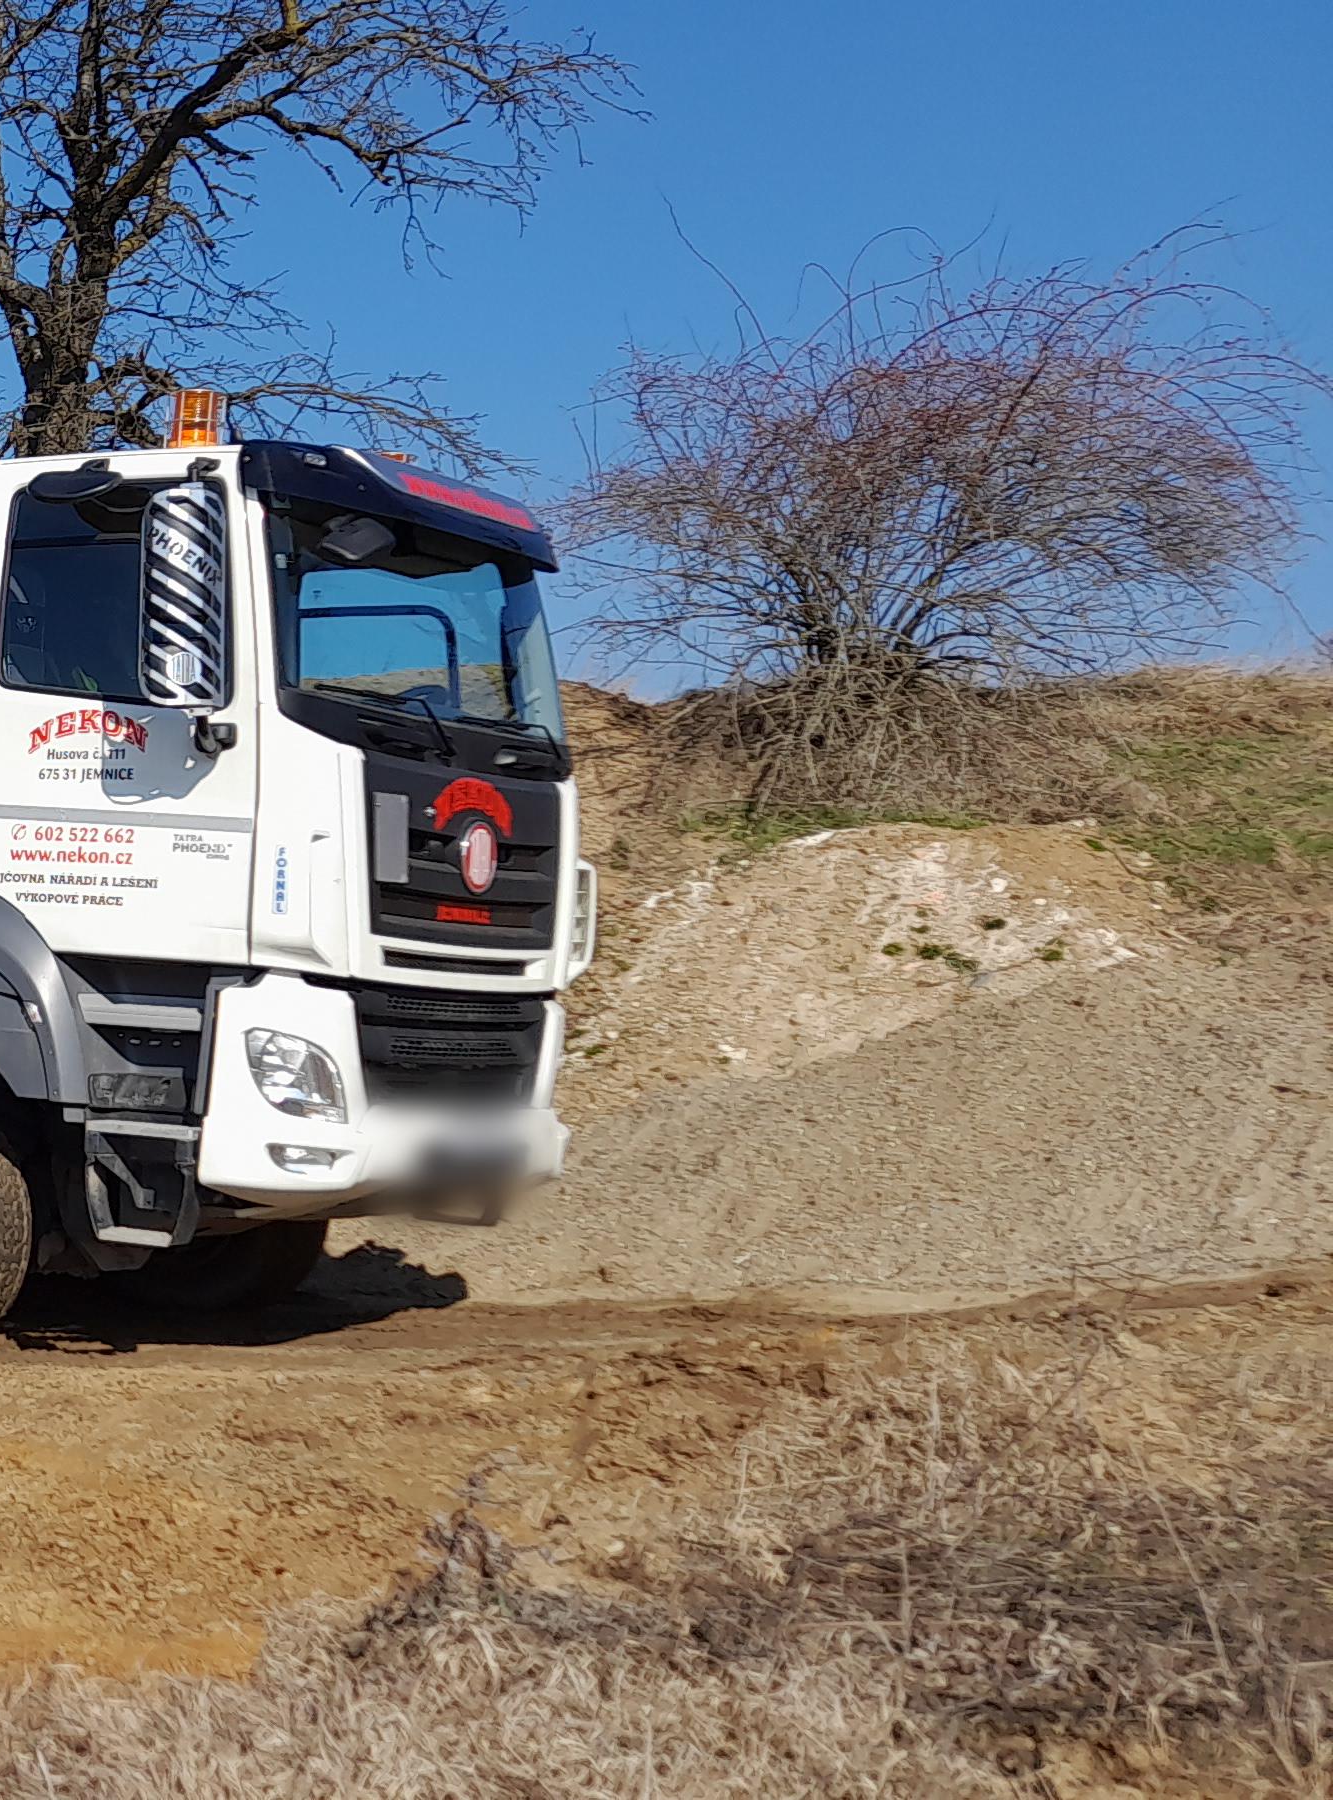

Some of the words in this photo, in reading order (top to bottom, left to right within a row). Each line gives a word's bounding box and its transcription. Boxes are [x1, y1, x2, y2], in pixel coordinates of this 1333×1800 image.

[148, 526, 222, 586] PHOENIX
[28, 709, 148, 754] NEKON
[47, 749, 88, 760] Husova
[108, 748, 125, 760] 111
[38, 768, 59, 780] 675
[62, 768, 76, 780] 31
[80, 768, 134, 783] JEMNICE
[34, 826, 64, 842] 602
[68, 827, 98, 842] 522
[104, 828, 134, 843] 662
[10, 846, 133, 864] www.nekon.cz
[100, 876, 108, 886] A
